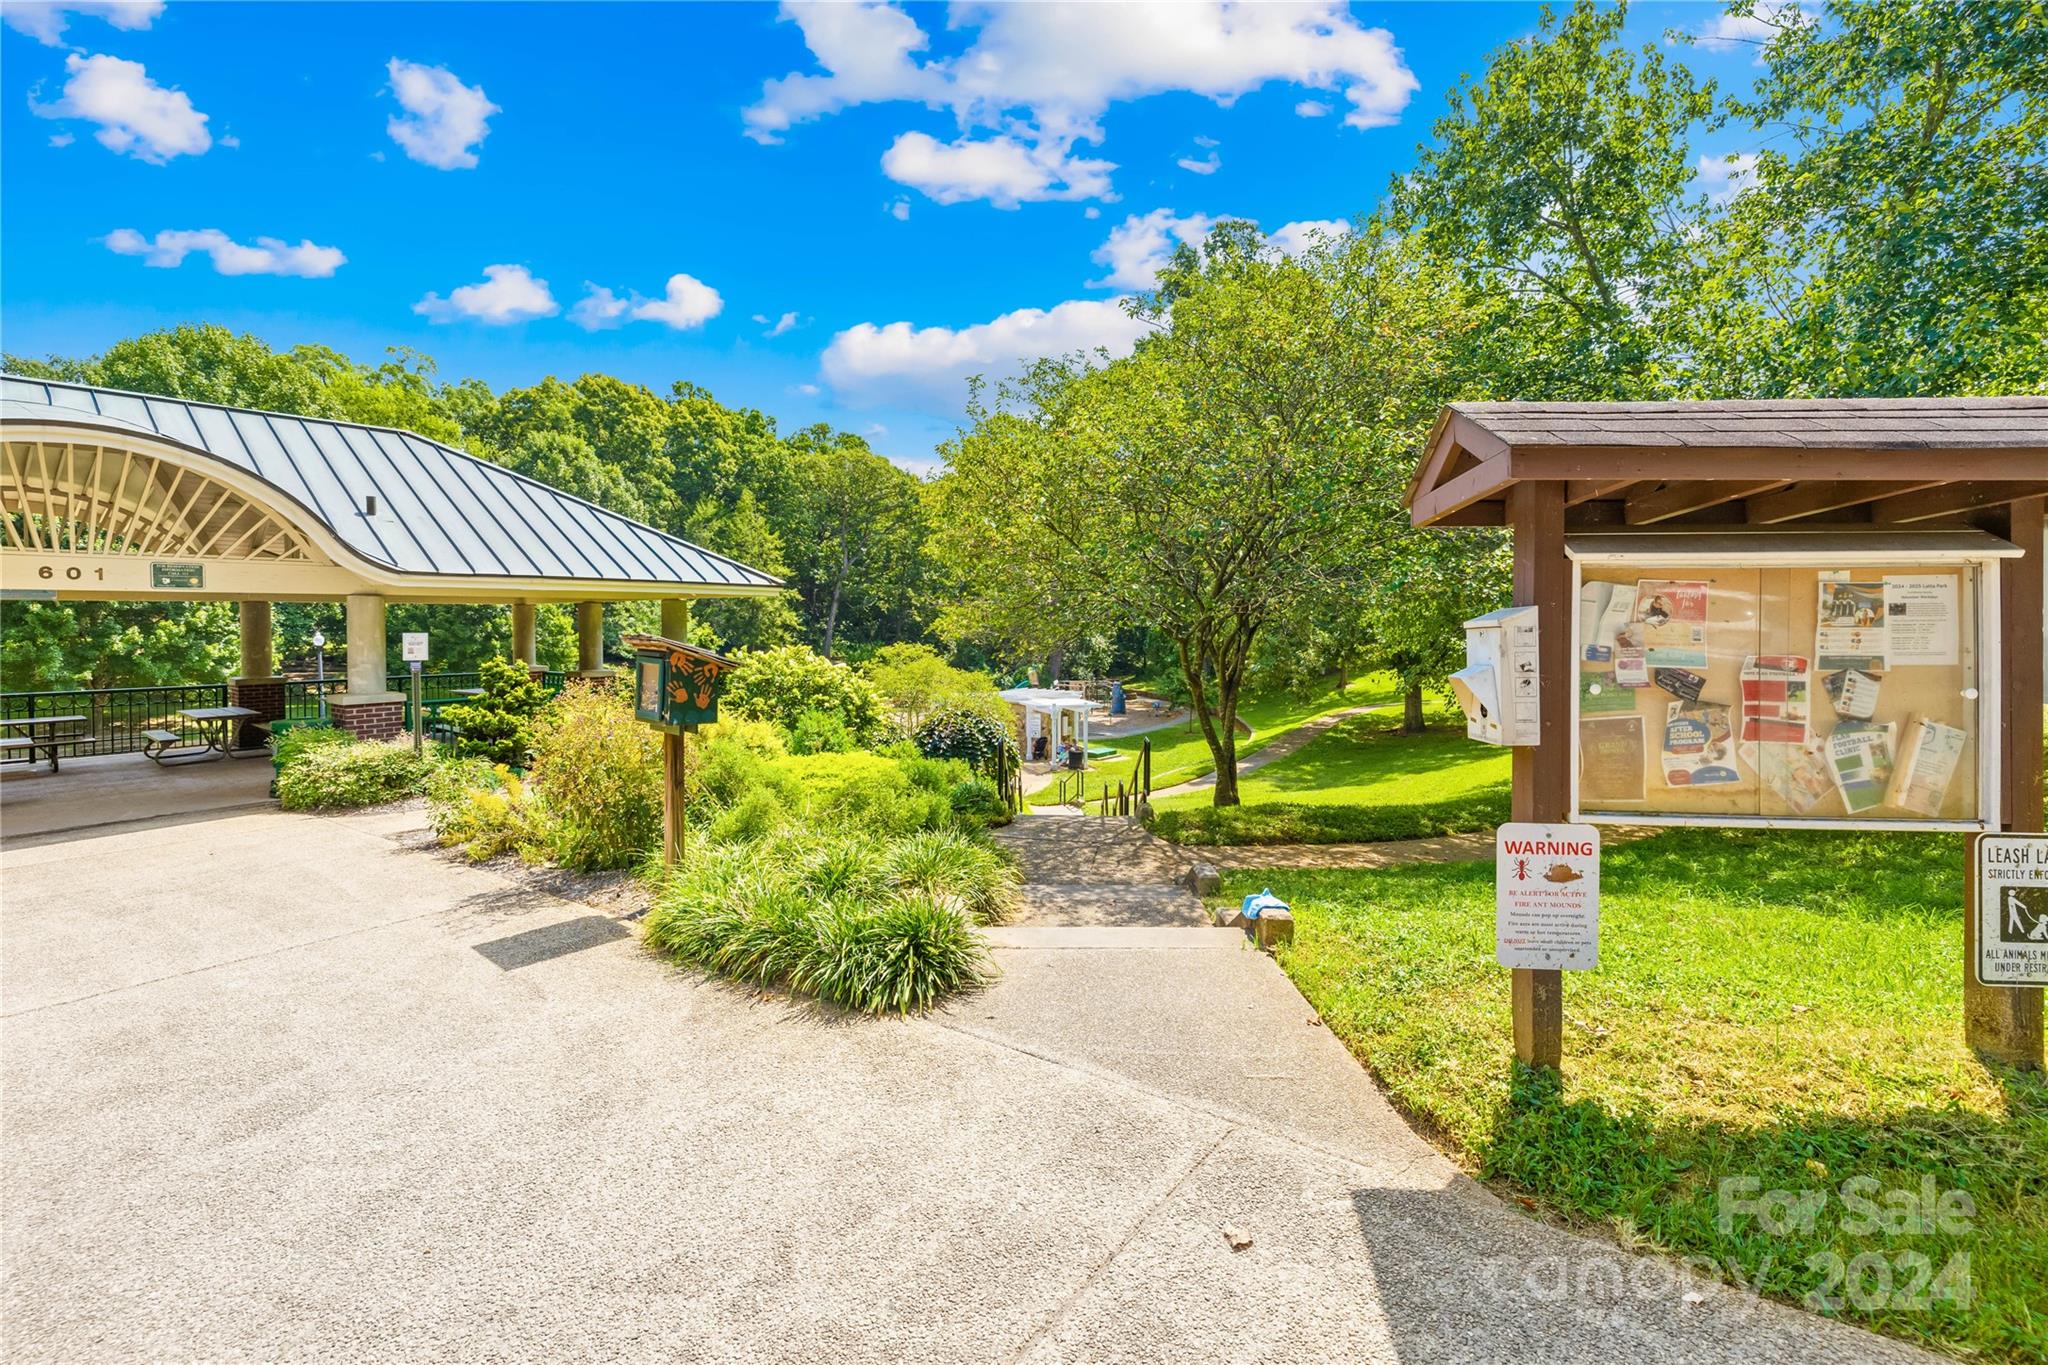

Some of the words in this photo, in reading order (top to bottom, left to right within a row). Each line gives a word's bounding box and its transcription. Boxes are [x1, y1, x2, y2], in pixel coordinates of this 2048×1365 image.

[38, 565, 104, 581] 601
[1669, 731, 1704, 740] SCHOOL
[1669, 738, 1705, 746] PROGRAM
[1833, 735, 1874, 749] FOOTBALL
[1834, 745, 1861, 756] CLINIC
[1504, 840, 1593, 856] WARNING
[1987, 847, 2030, 864] LEASH
[1987, 868, 2026, 880] STRICTLY
[1985, 949, 2003, 960] ALL
[2003, 949, 2037, 960] ANIMALS
[1994, 962, 2021, 973] UNDER
